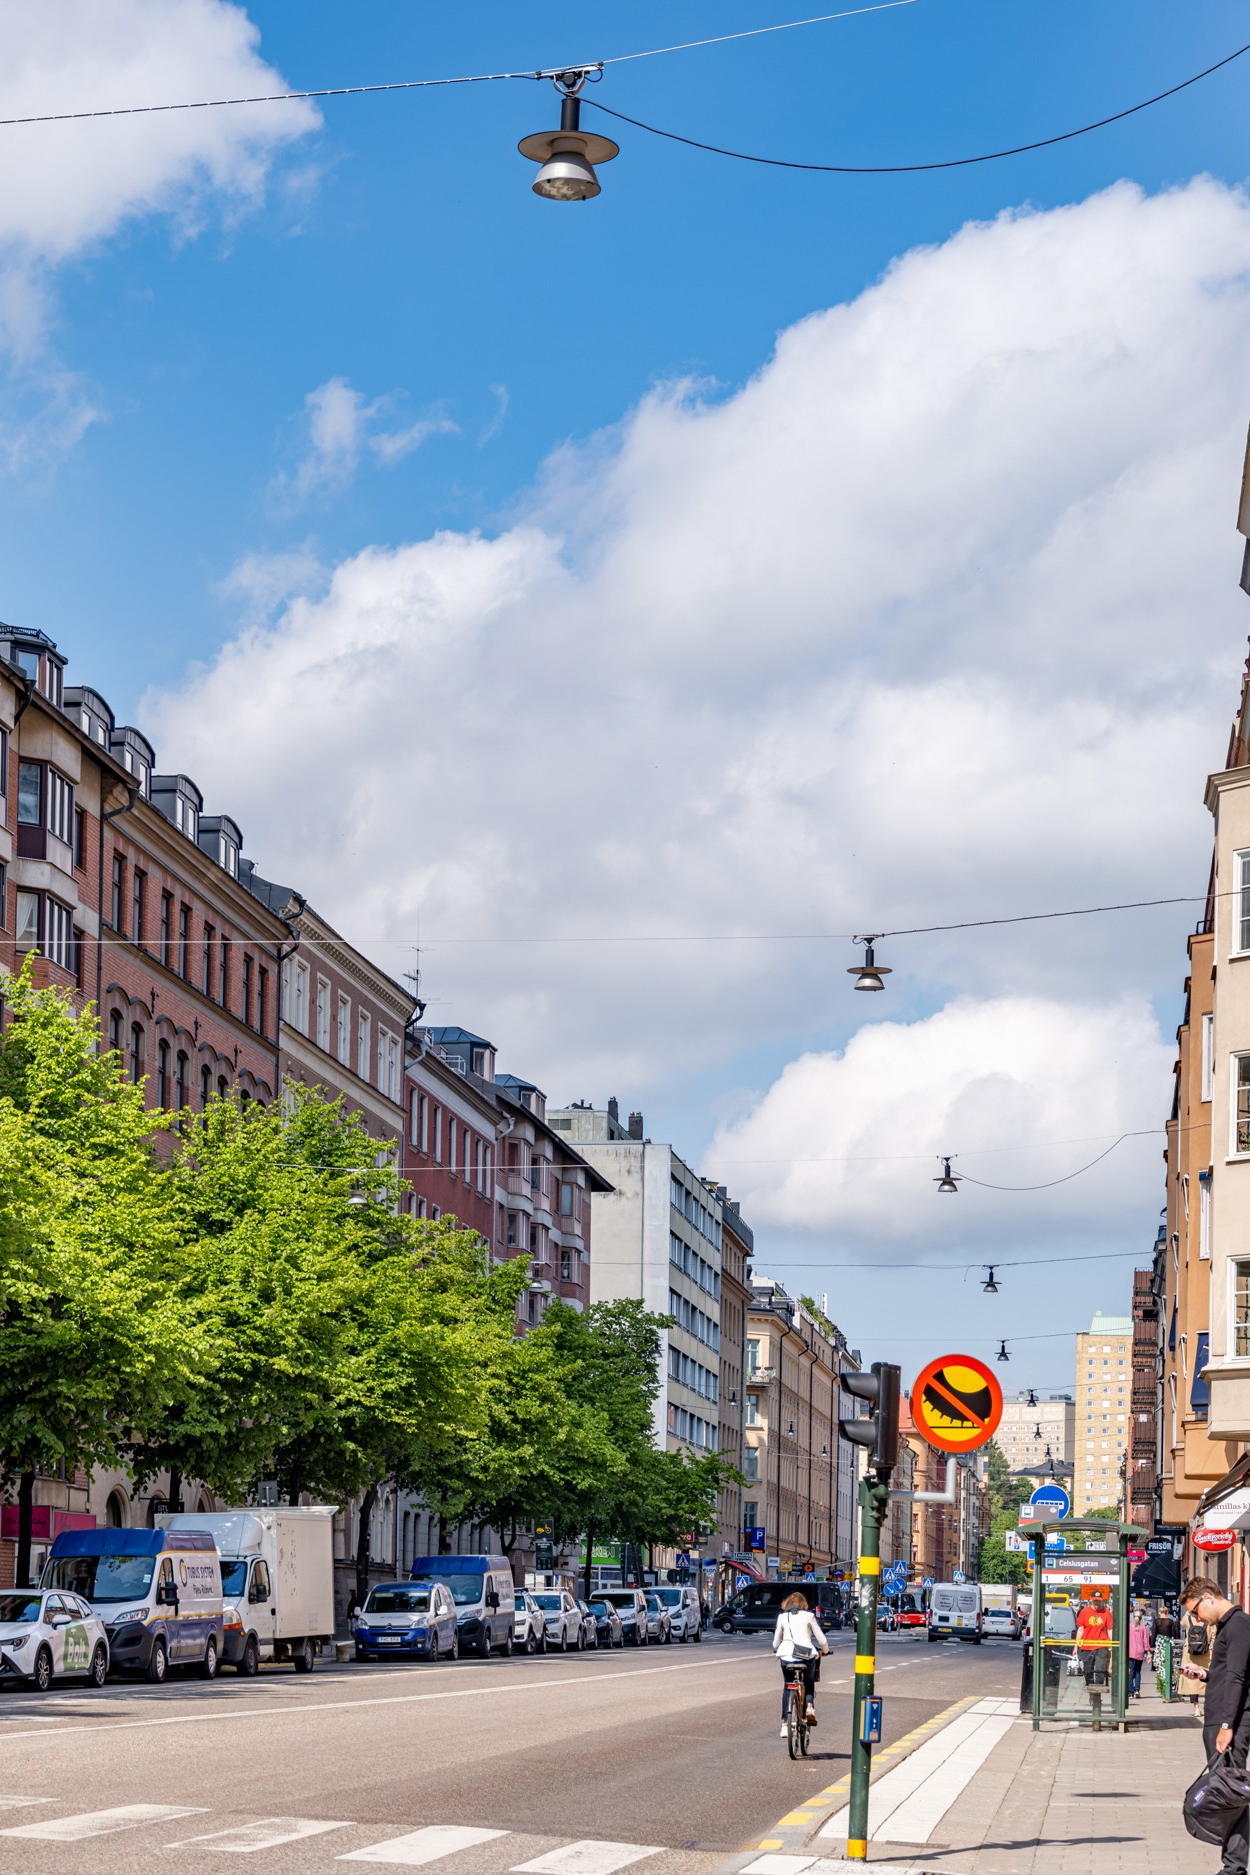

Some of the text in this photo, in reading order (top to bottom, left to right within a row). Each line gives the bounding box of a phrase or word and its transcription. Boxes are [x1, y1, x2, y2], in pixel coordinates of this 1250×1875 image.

[1148, 1542, 1172, 1550] FRISÖR
[1059, 1559, 1099, 1569] Celsiusgatan
[200, 1566, 215, 1579] SYSTEM
